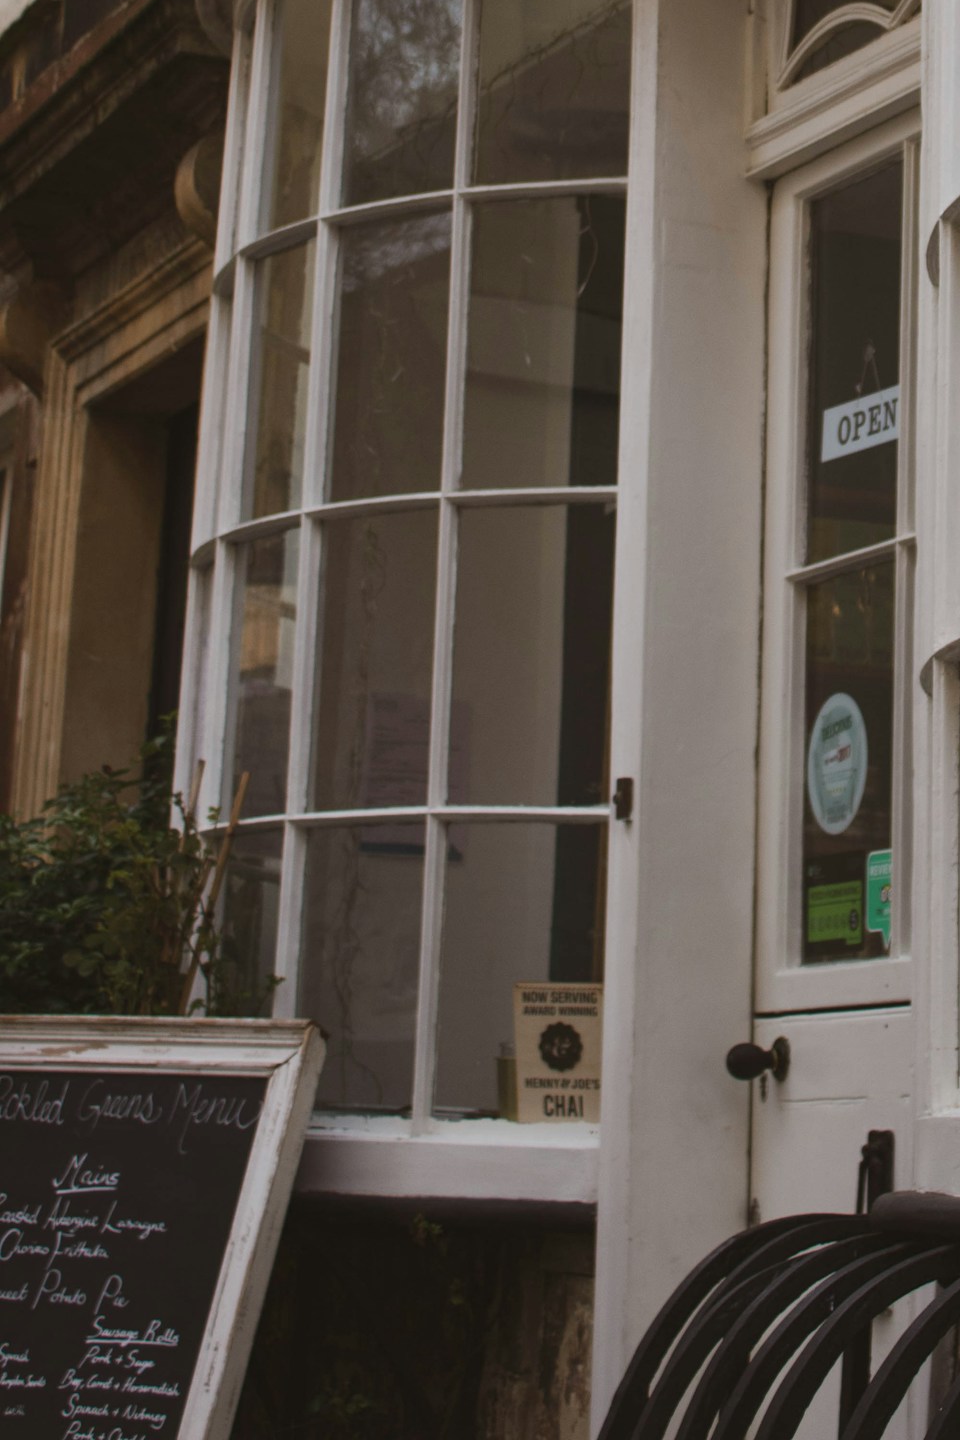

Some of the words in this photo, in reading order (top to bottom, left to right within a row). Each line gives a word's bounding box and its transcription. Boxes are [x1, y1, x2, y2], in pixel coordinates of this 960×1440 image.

[837, 398, 898, 446] OPEN
[522, 991, 548, 1004] NOW
[551, 991, 598, 1004] SERVING
[523, 1006, 556, 1017] AWARD
[558, 1006, 598, 1017] WINNING
[78, 1078, 163, 1130] Greens
[168, 1082, 264, 1155] Menu
[543, 1094, 585, 1118] CHAI
[52, 1153, 120, 1191] Mains
[101, 1200, 168, 1240] Lasagne
[32, 1268, 87, 1310] Potato
[94, 1274, 130, 1316] Pie
[87, 1315, 139, 1347] Sausage
[143, 1319, 180, 1344] Rolls
[78, 1345, 113, 1369] Pork
[125, 1348, 156, 1375] Sage
[61, 1393, 110, 1420] Spinach
